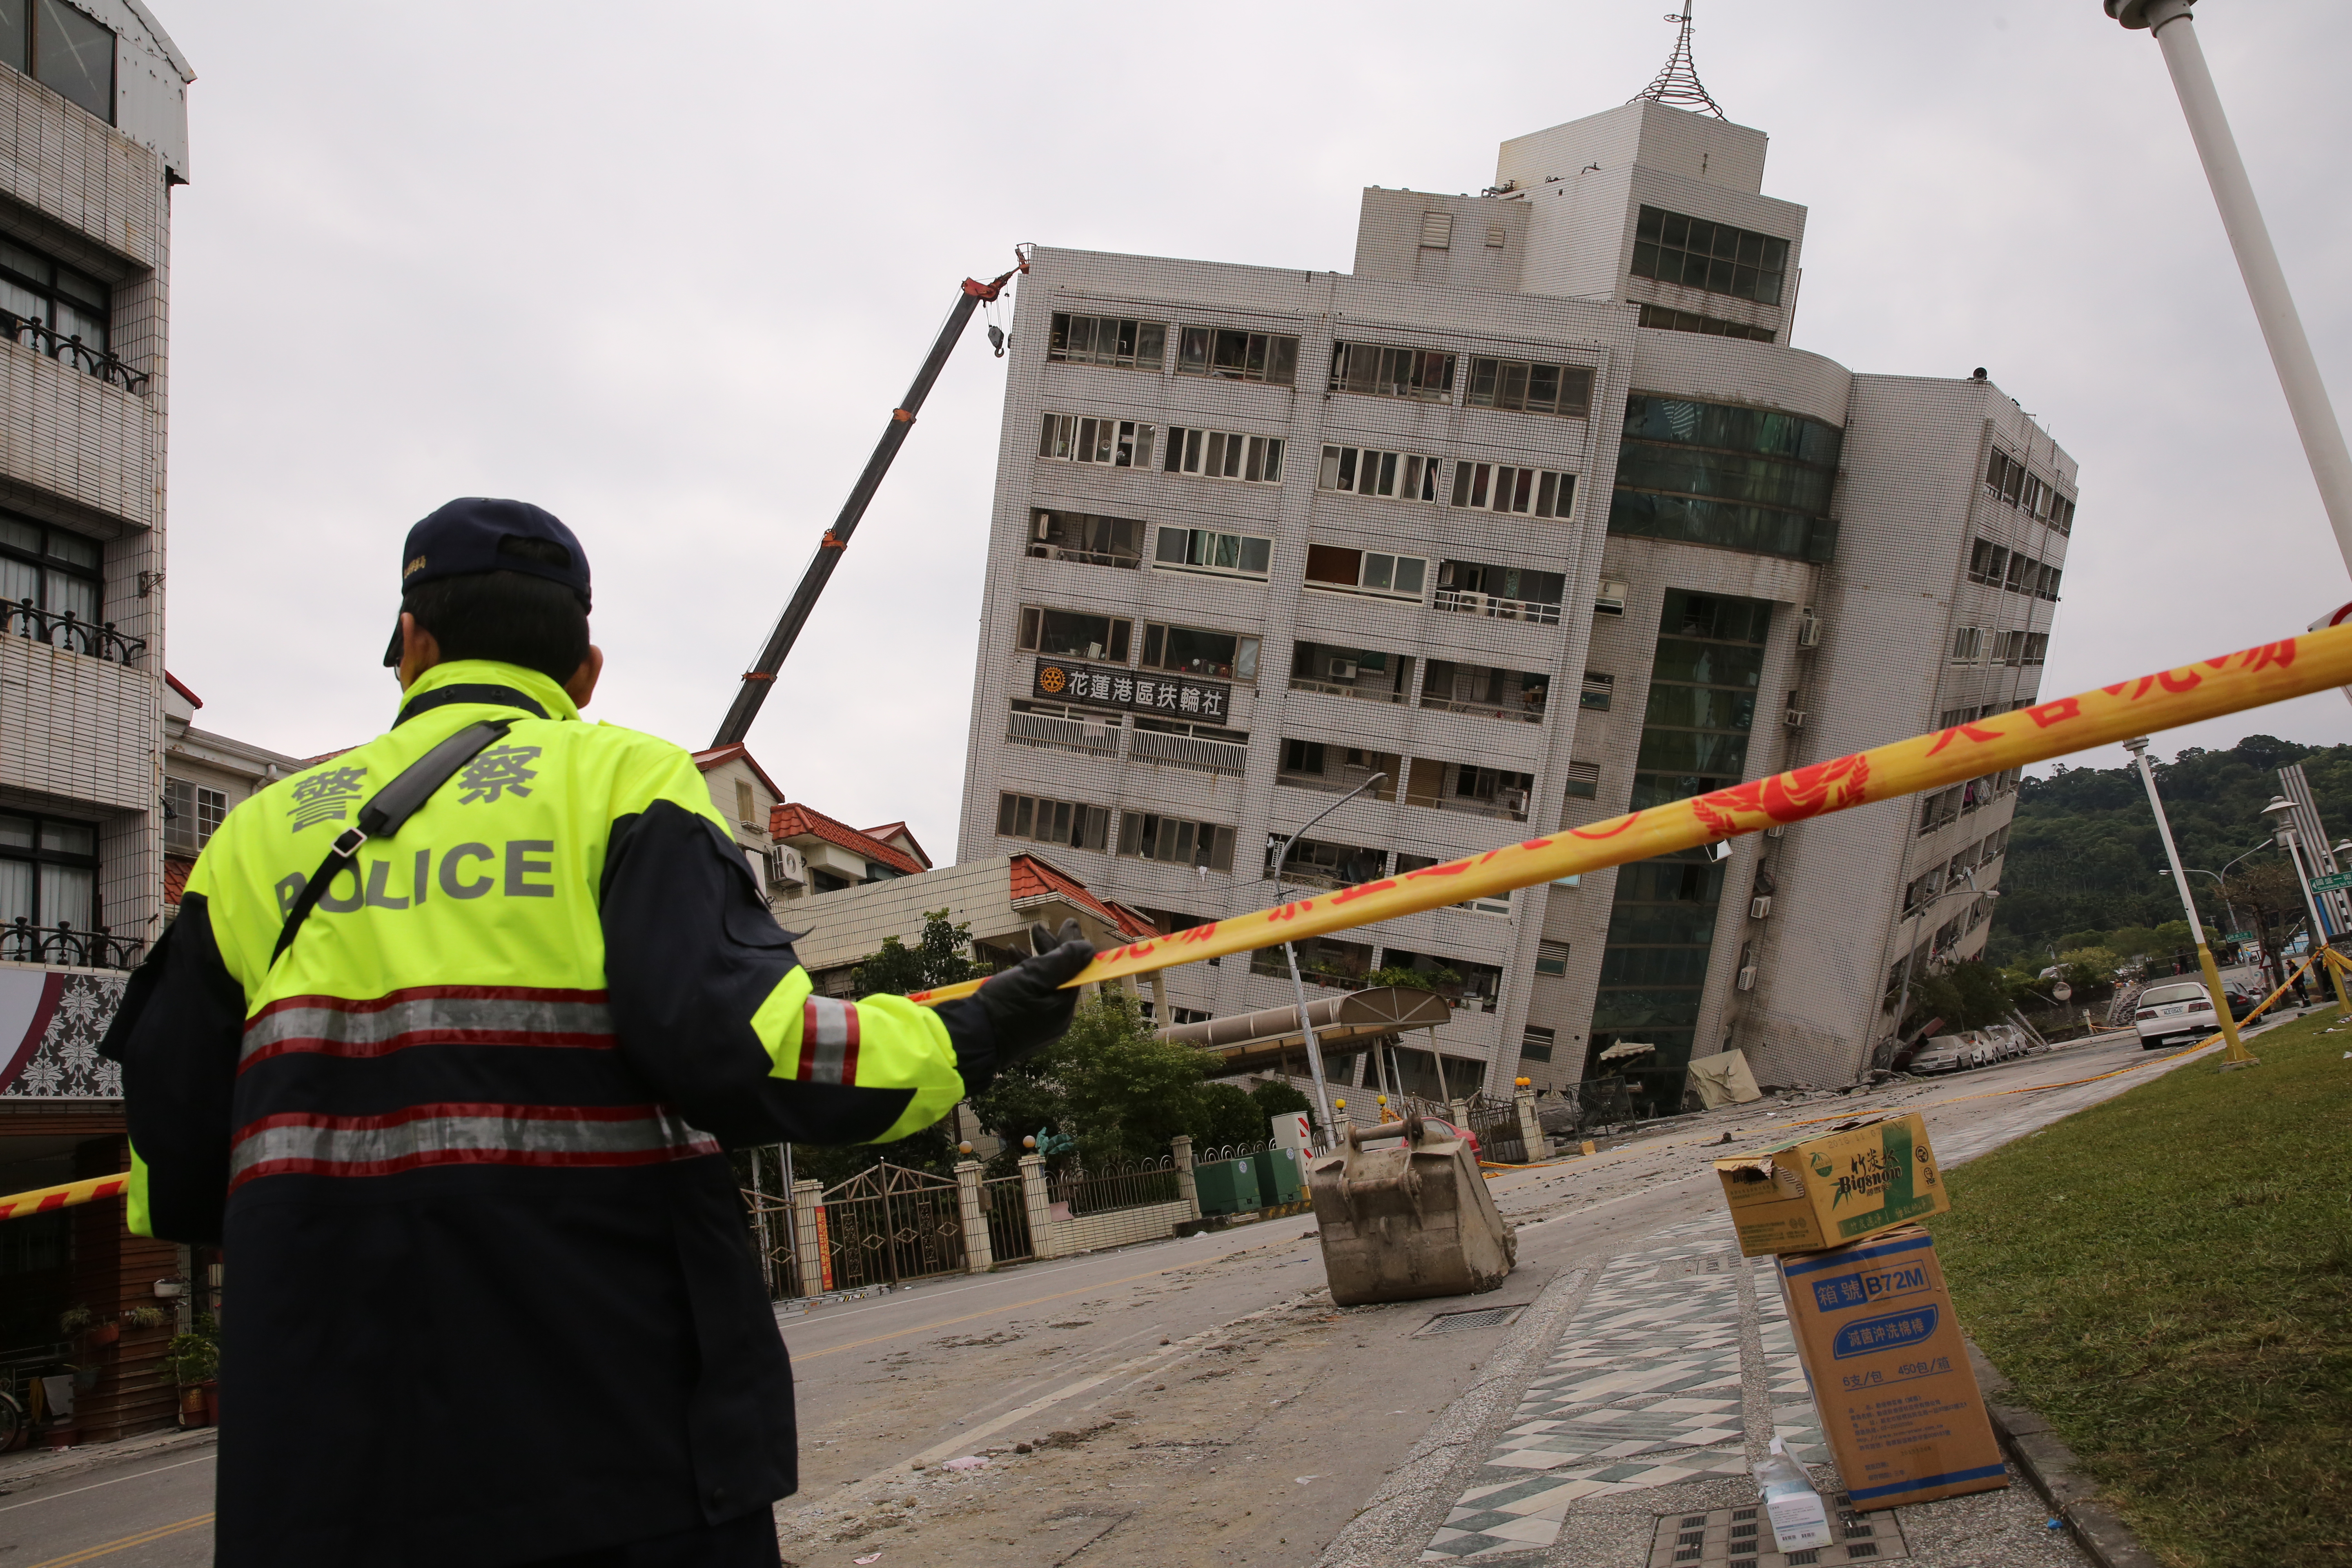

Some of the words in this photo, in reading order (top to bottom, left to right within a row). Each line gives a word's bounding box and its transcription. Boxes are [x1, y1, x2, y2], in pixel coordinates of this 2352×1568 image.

[1069, 671, 1223, 715] 花蓮港區扶輪社
[287, 744, 542, 833] 警察
[275, 840, 554, 922] POLICE
[1851, 1146, 1899, 1176] 竹炭水
[1838, 1166, 1902, 1195] Bigsnow
[817, 1212, 827, 1275] 請勿在此停車
[1817, 1280, 1863, 1305] 箱號
[1865, 1268, 1924, 1295] B72M
[1847, 1321, 1925, 1347] 滅菌沖洗棉棒
[1842, 1370, 1884, 1388] 6支/包
[1898, 1357, 1950, 1376] 450包/箱
